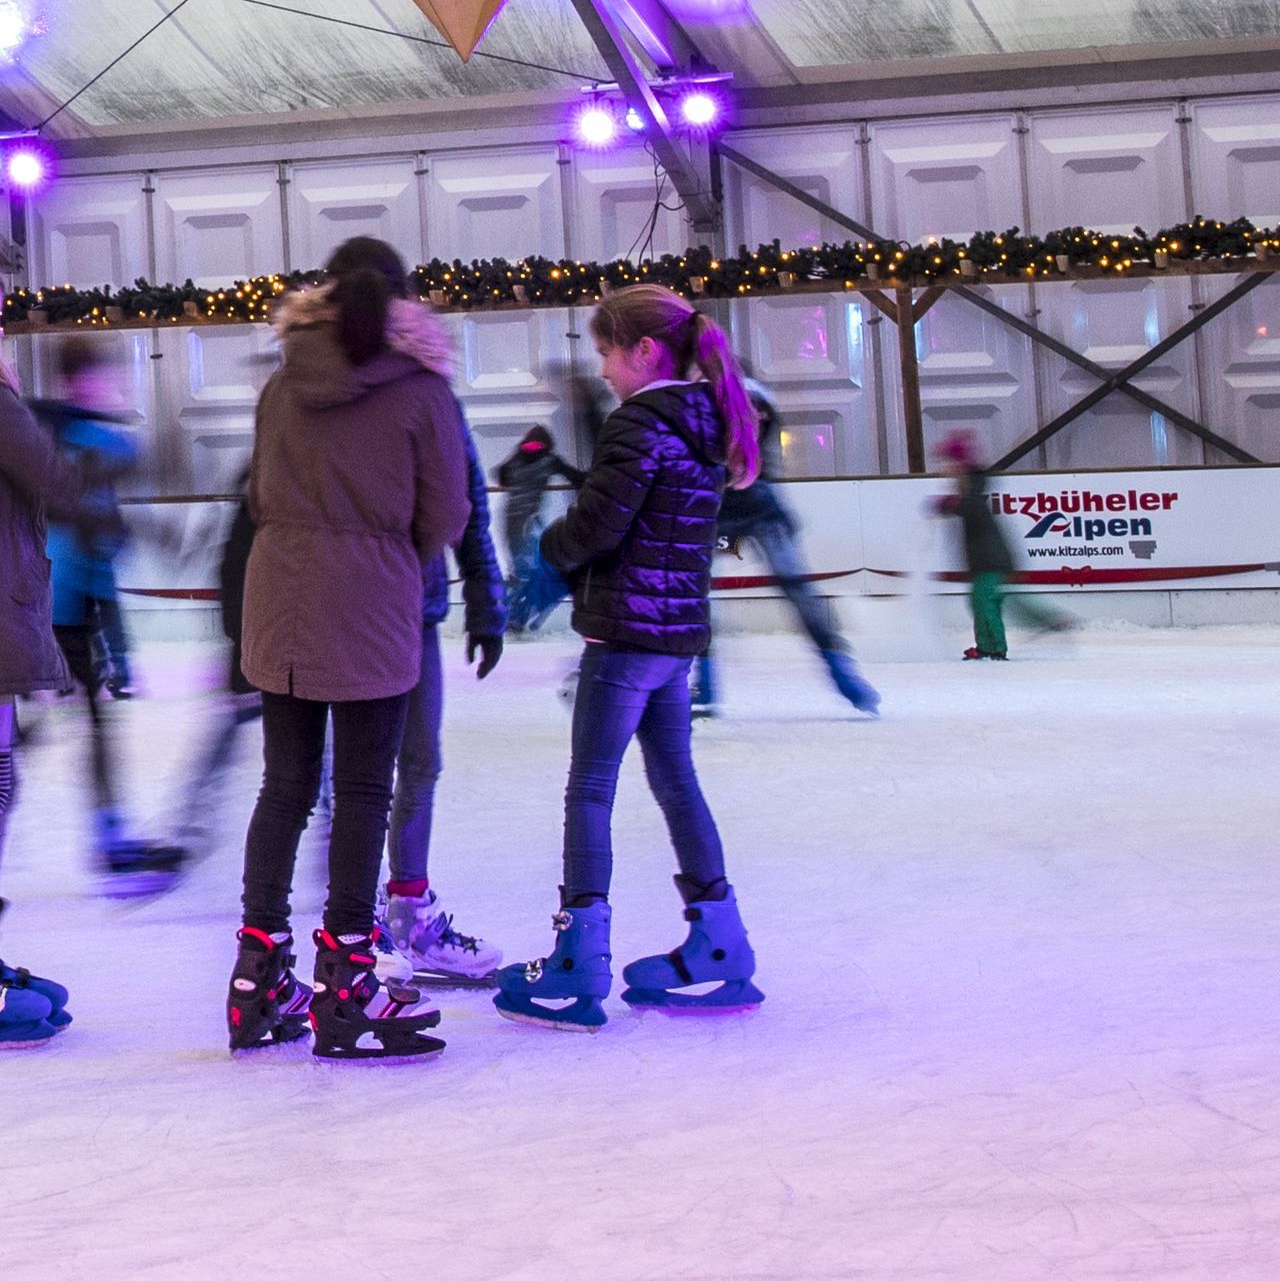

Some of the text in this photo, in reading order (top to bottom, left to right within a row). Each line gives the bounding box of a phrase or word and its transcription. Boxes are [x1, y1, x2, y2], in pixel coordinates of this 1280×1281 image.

[989, 490, 1178, 522] itzbüheler
[1024, 512, 1152, 541] Alpen
[1028, 545, 1124, 558] www.kitzalps.com
